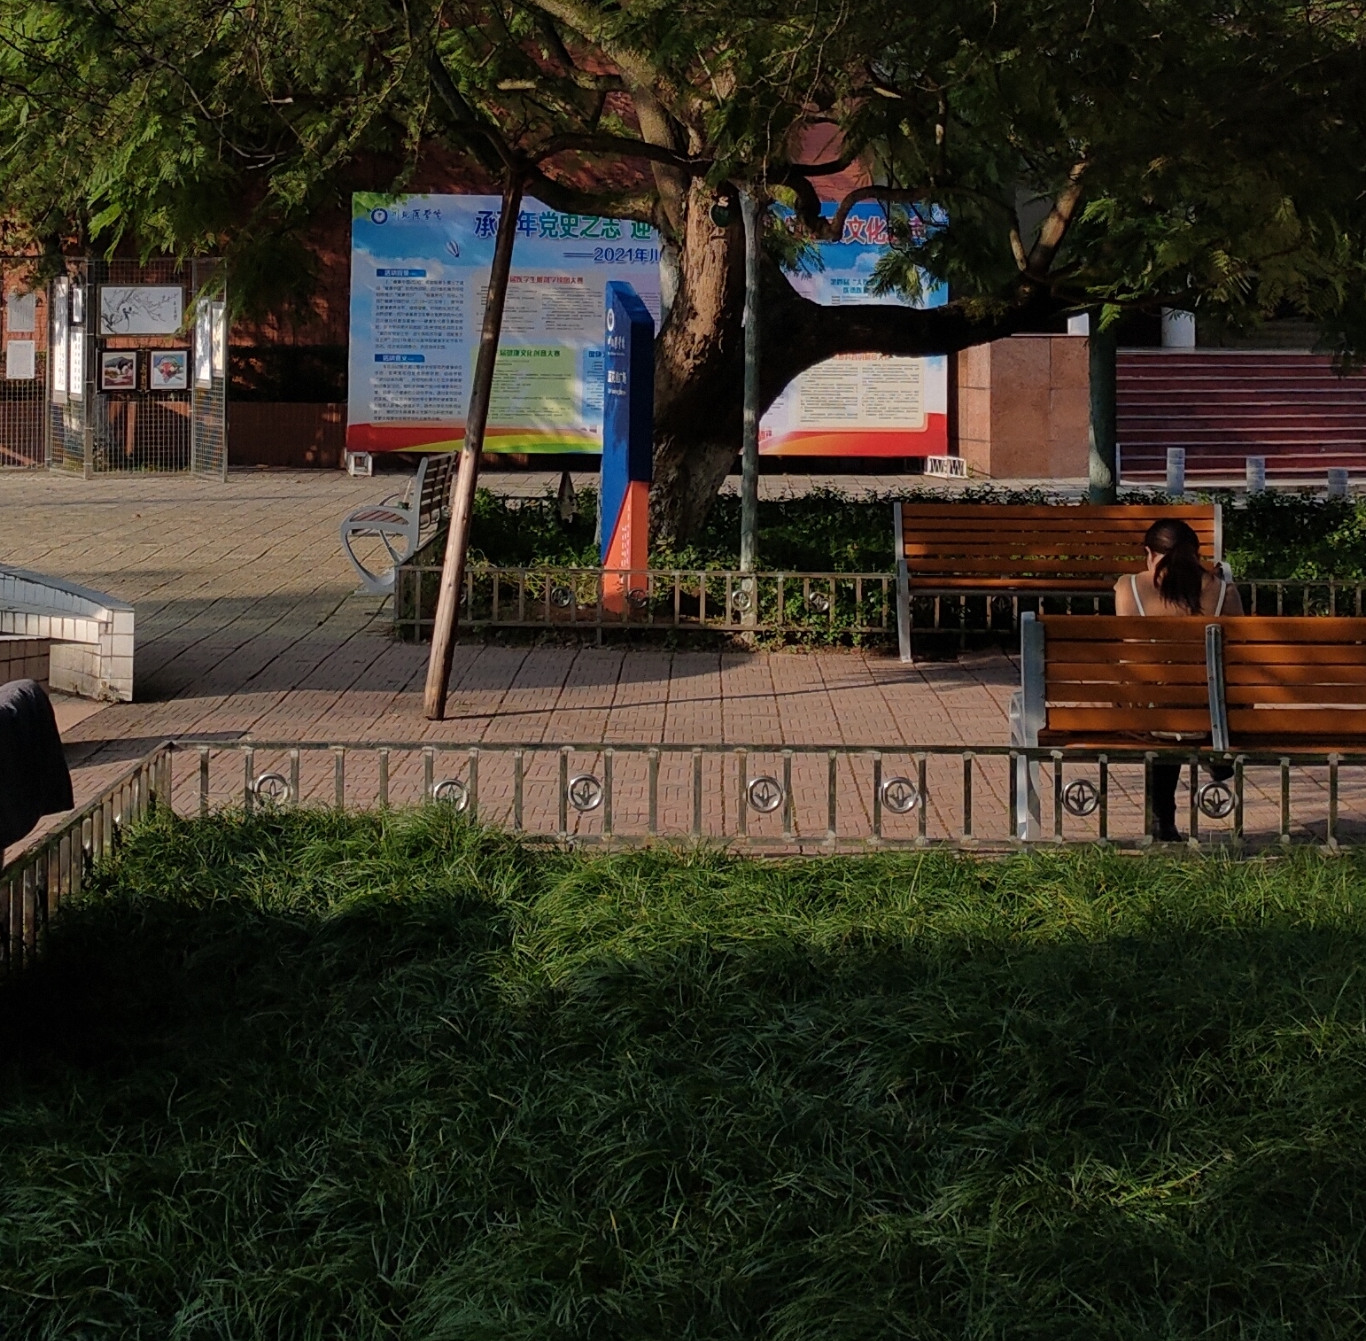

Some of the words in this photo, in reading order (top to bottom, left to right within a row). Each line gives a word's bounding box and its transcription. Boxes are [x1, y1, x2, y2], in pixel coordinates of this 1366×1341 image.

[474, 210, 621, 239] 承年党史之志
